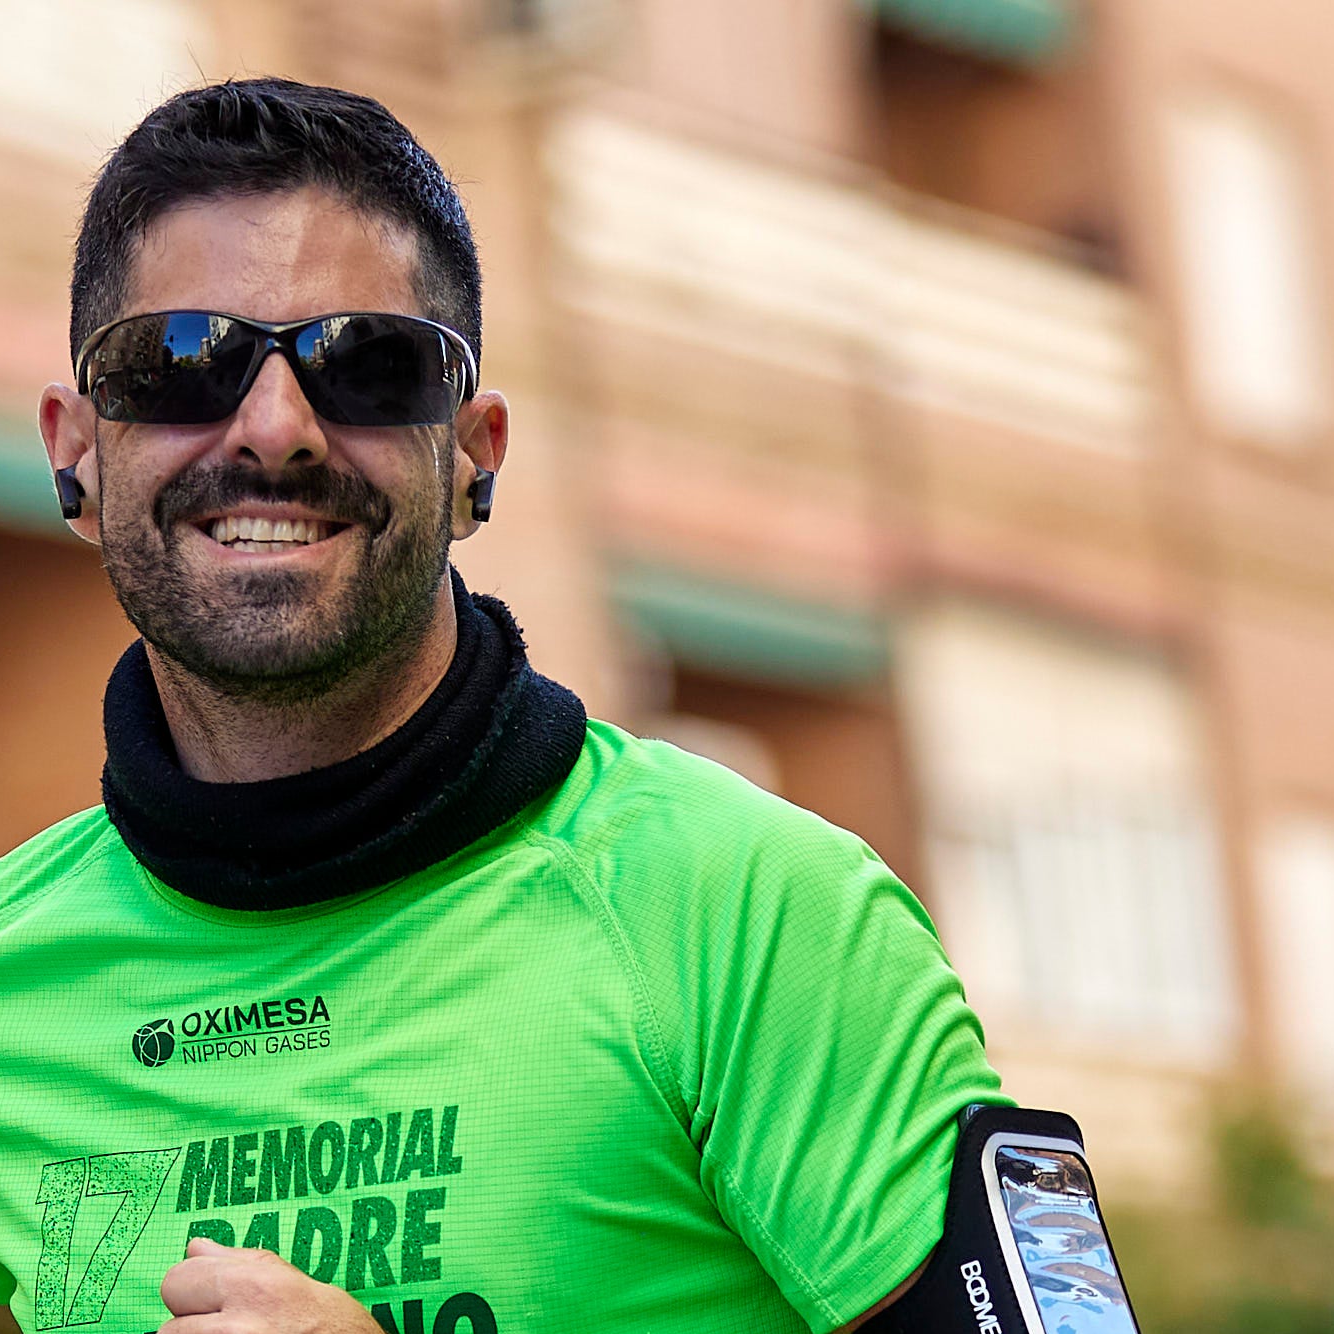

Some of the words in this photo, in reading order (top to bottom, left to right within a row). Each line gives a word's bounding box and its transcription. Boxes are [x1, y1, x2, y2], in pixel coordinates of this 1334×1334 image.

[180, 995, 331, 1038] OXIMESA
[182, 1038, 257, 1065] NIPPON
[265, 1029, 332, 1056] GASES
[175, 1105, 463, 1213] MEMORIAL
[35, 1146, 182, 1331] 17
[183, 1186, 447, 1291] DRE
